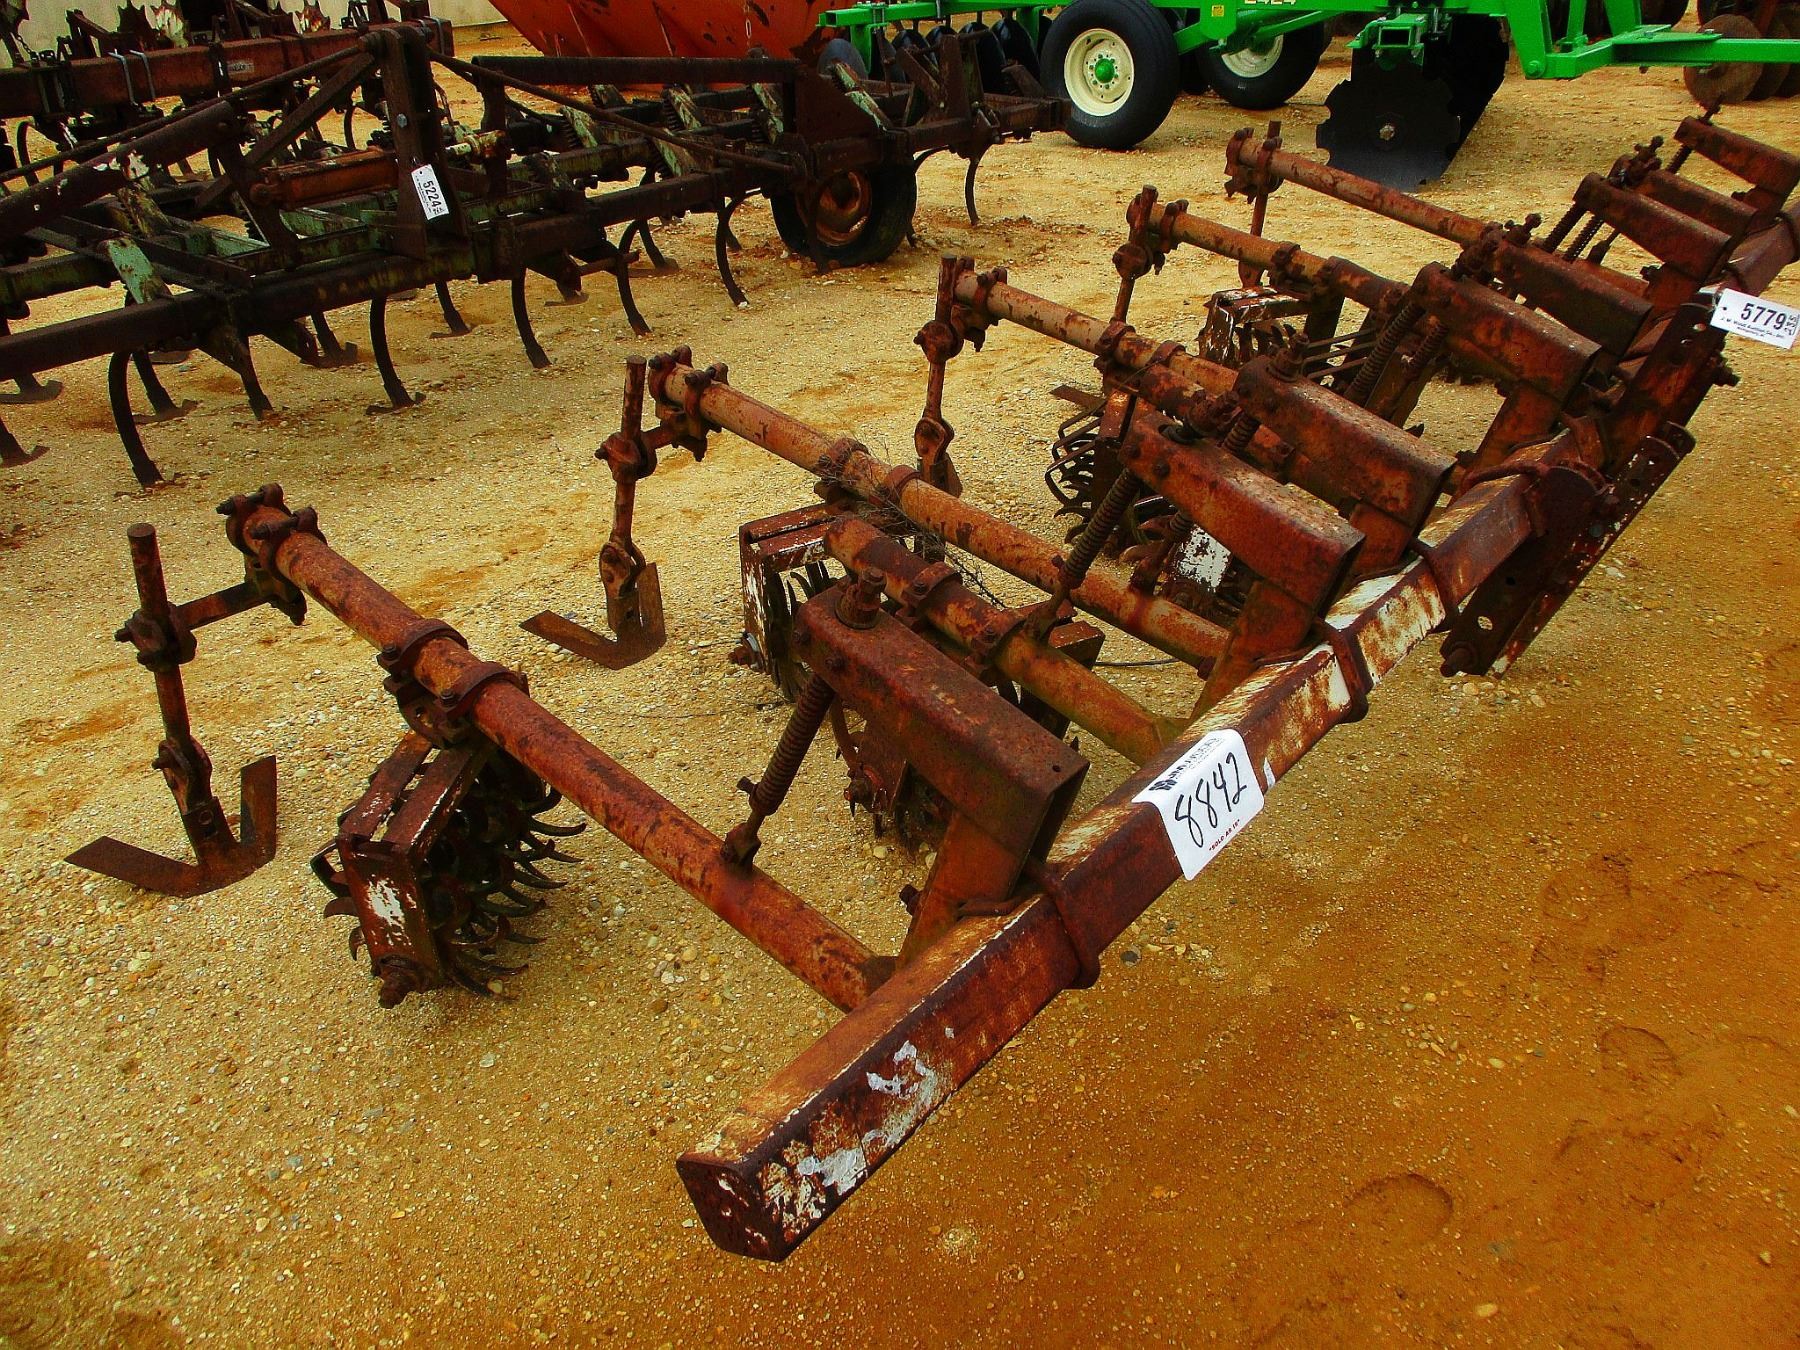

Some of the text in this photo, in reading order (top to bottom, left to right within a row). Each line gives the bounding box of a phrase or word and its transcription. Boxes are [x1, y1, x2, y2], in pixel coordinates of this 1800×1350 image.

[423, 181, 442, 207] 5224
[1741, 303, 1787, 330] 5779
[1175, 752, 1248, 848] 8842
